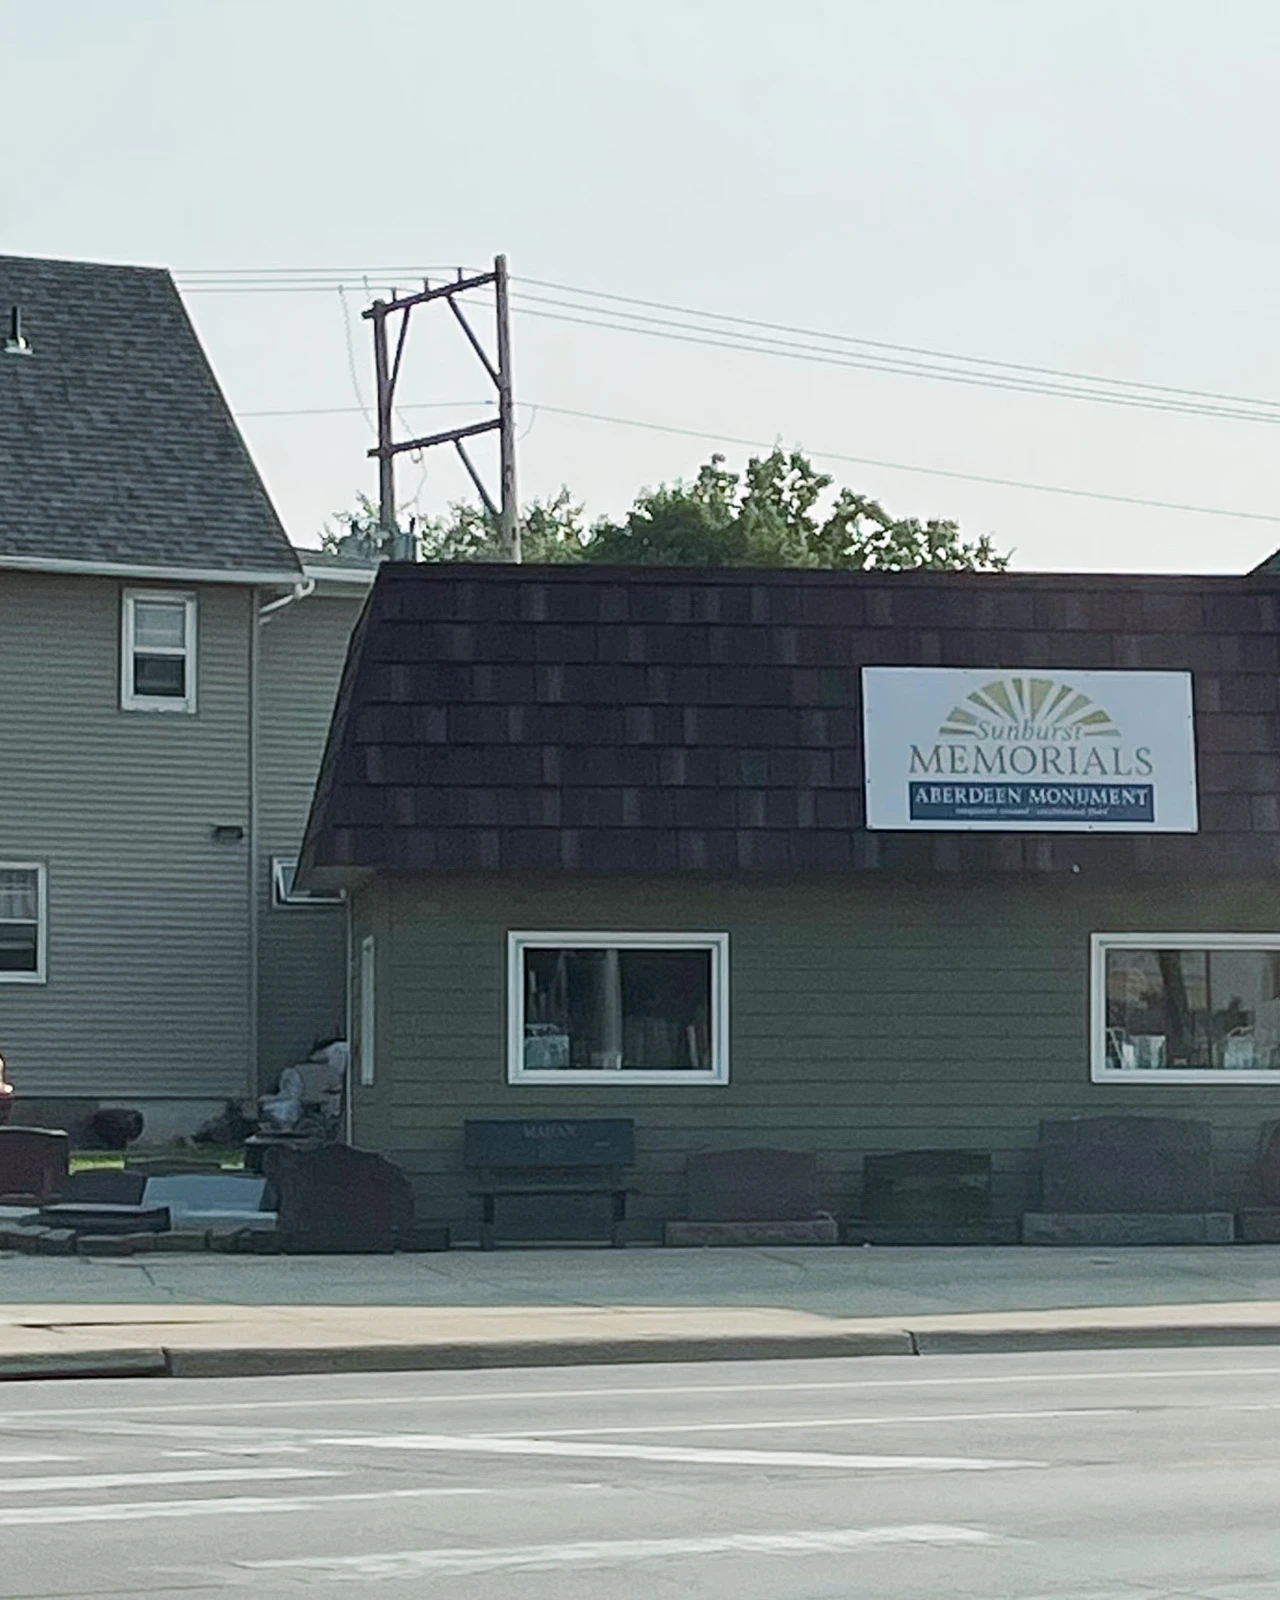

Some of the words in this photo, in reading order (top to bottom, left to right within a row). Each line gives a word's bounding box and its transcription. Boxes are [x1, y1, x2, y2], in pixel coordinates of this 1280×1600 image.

[977, 718, 1083, 741] Sunburst
[908, 744, 1153, 776] MEMORIALS
[915, 787, 1022, 805] ABERDEEN
[1029, 788, 1149, 806] MONUMENT
